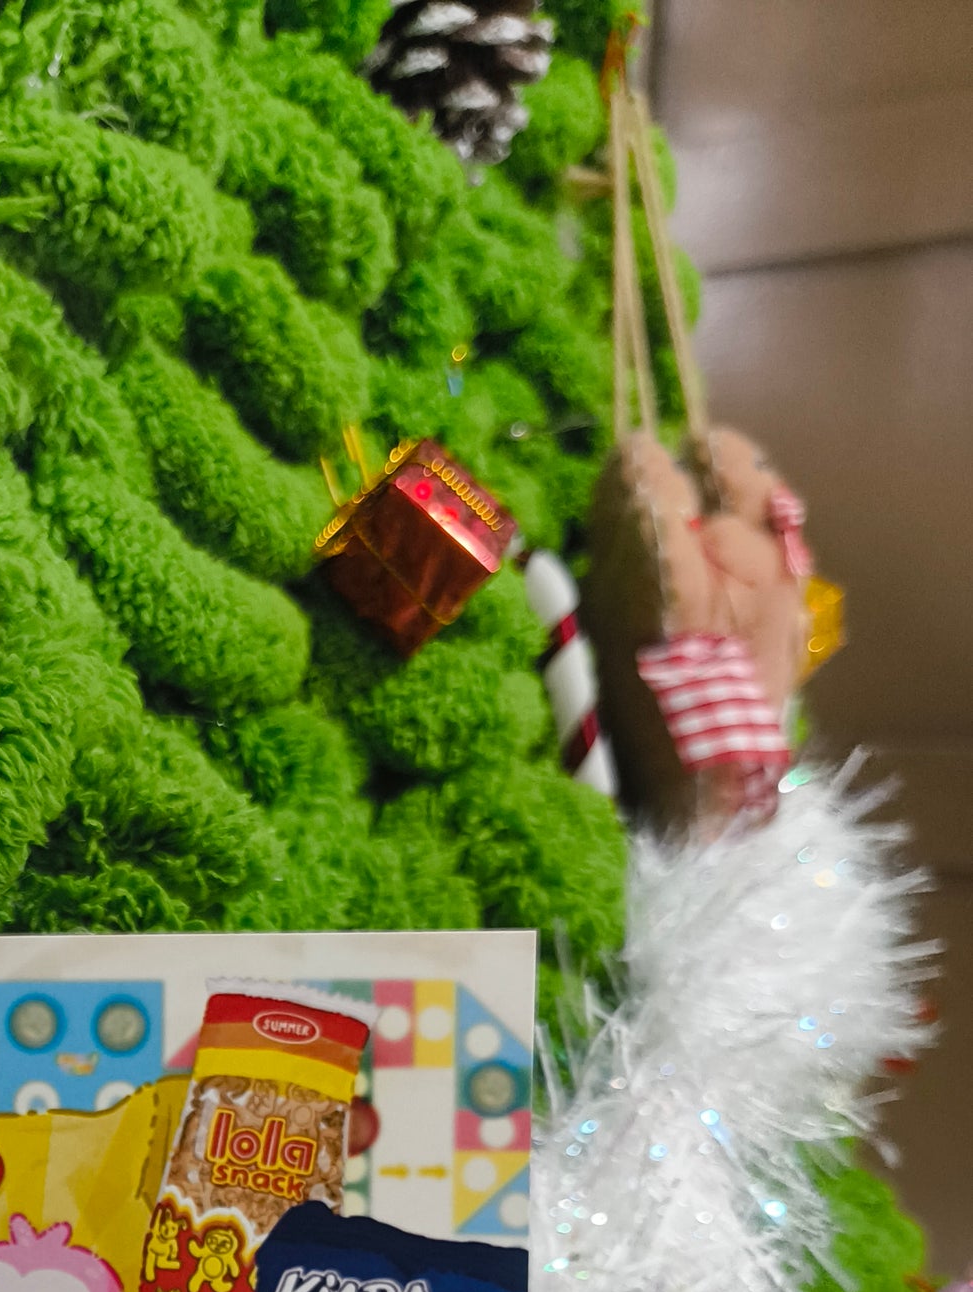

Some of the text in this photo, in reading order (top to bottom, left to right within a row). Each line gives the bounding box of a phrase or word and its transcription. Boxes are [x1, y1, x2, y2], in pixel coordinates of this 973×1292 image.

[263, 1018, 310, 1038] SUMMER
[206, 1108, 317, 1175] lola
[211, 1162, 307, 1201] snack
